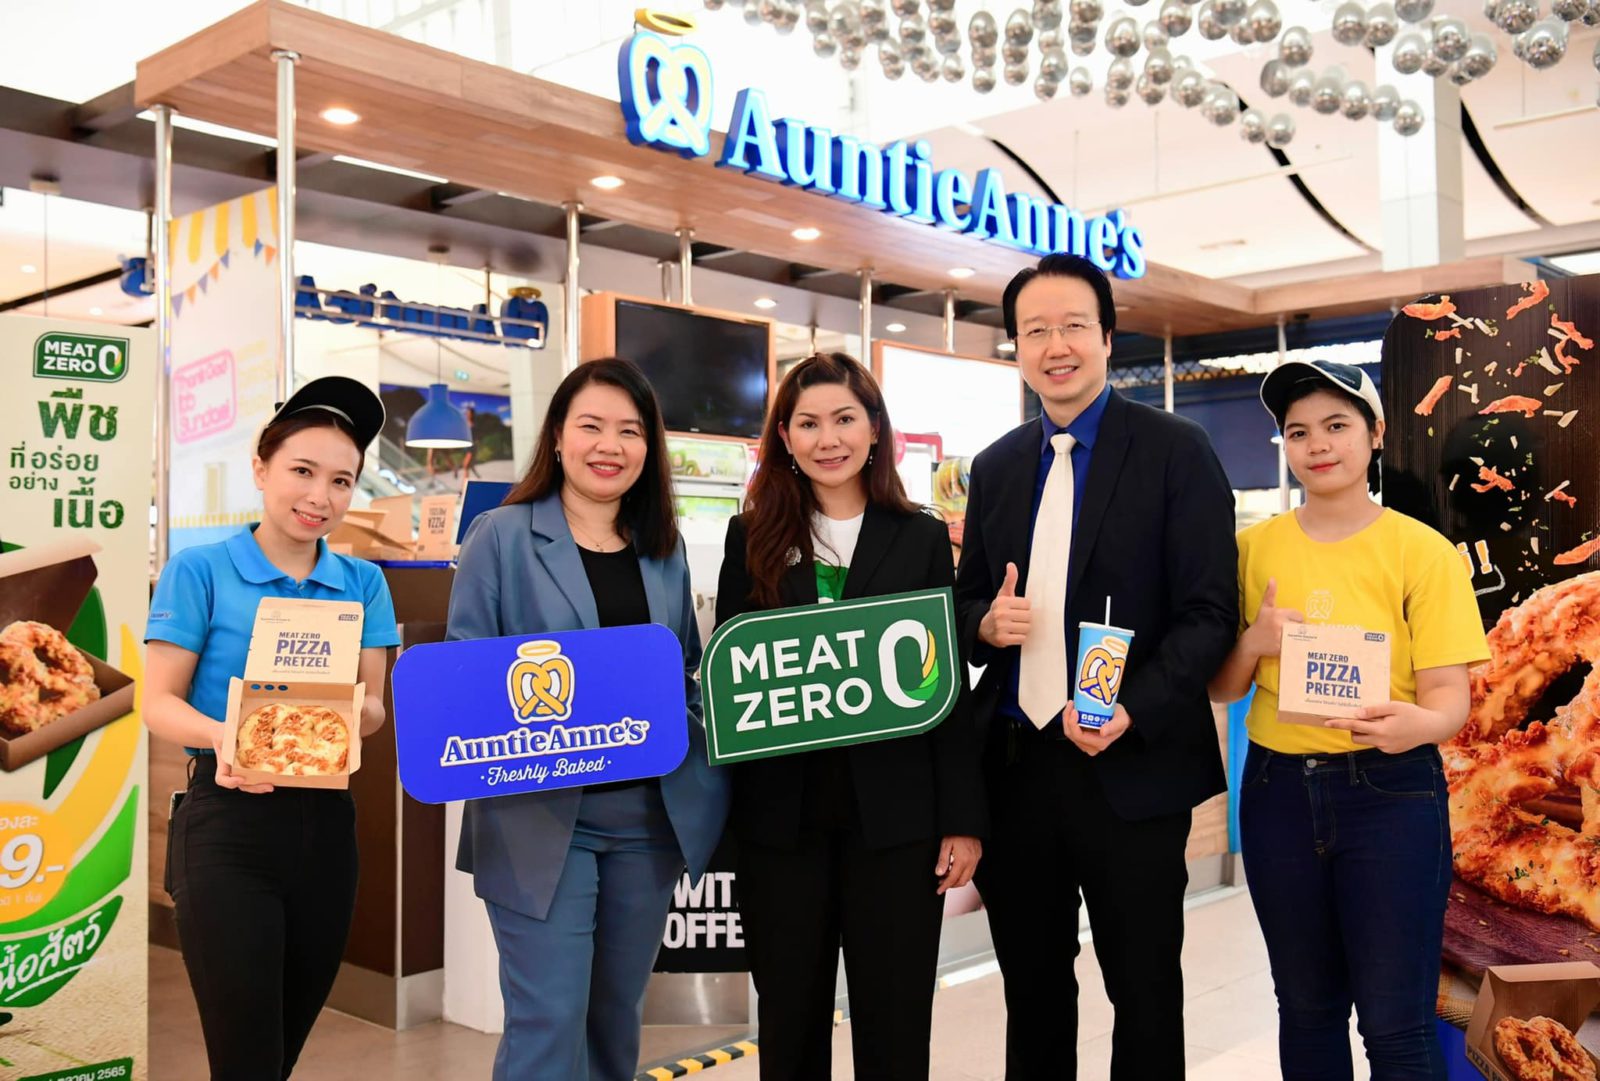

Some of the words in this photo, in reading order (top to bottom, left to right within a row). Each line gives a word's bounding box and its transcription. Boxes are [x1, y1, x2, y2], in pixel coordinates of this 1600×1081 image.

[43, 340, 97, 358] MEAT
[42, 355, 97, 373] ZERO
[37, 387, 119, 441] พืช
[9, 472, 59, 491] อย่าง
[53, 477, 125, 529] เนื้อ
[278, 631, 299, 639] MEAT
[300, 632, 321, 640] ZERO
[275, 639, 332, 656] PIZZA
[273, 655, 330, 668] PRETZEL
[729, 629, 866, 685] MEAT
[1307, 651, 1328, 661] MEAT
[1328, 653, 1349, 663] ZERO
[1306, 661, 1362, 685] PIZZA
[1305, 681, 1362, 699] PRETZEL
[732, 676, 873, 733] ZERO
[486, 761, 550, 786] Freshly
[551, 755, 606, 778] Baked
[673, 871, 739, 908] WIT
[97, 1065, 126, 1080] 2565
